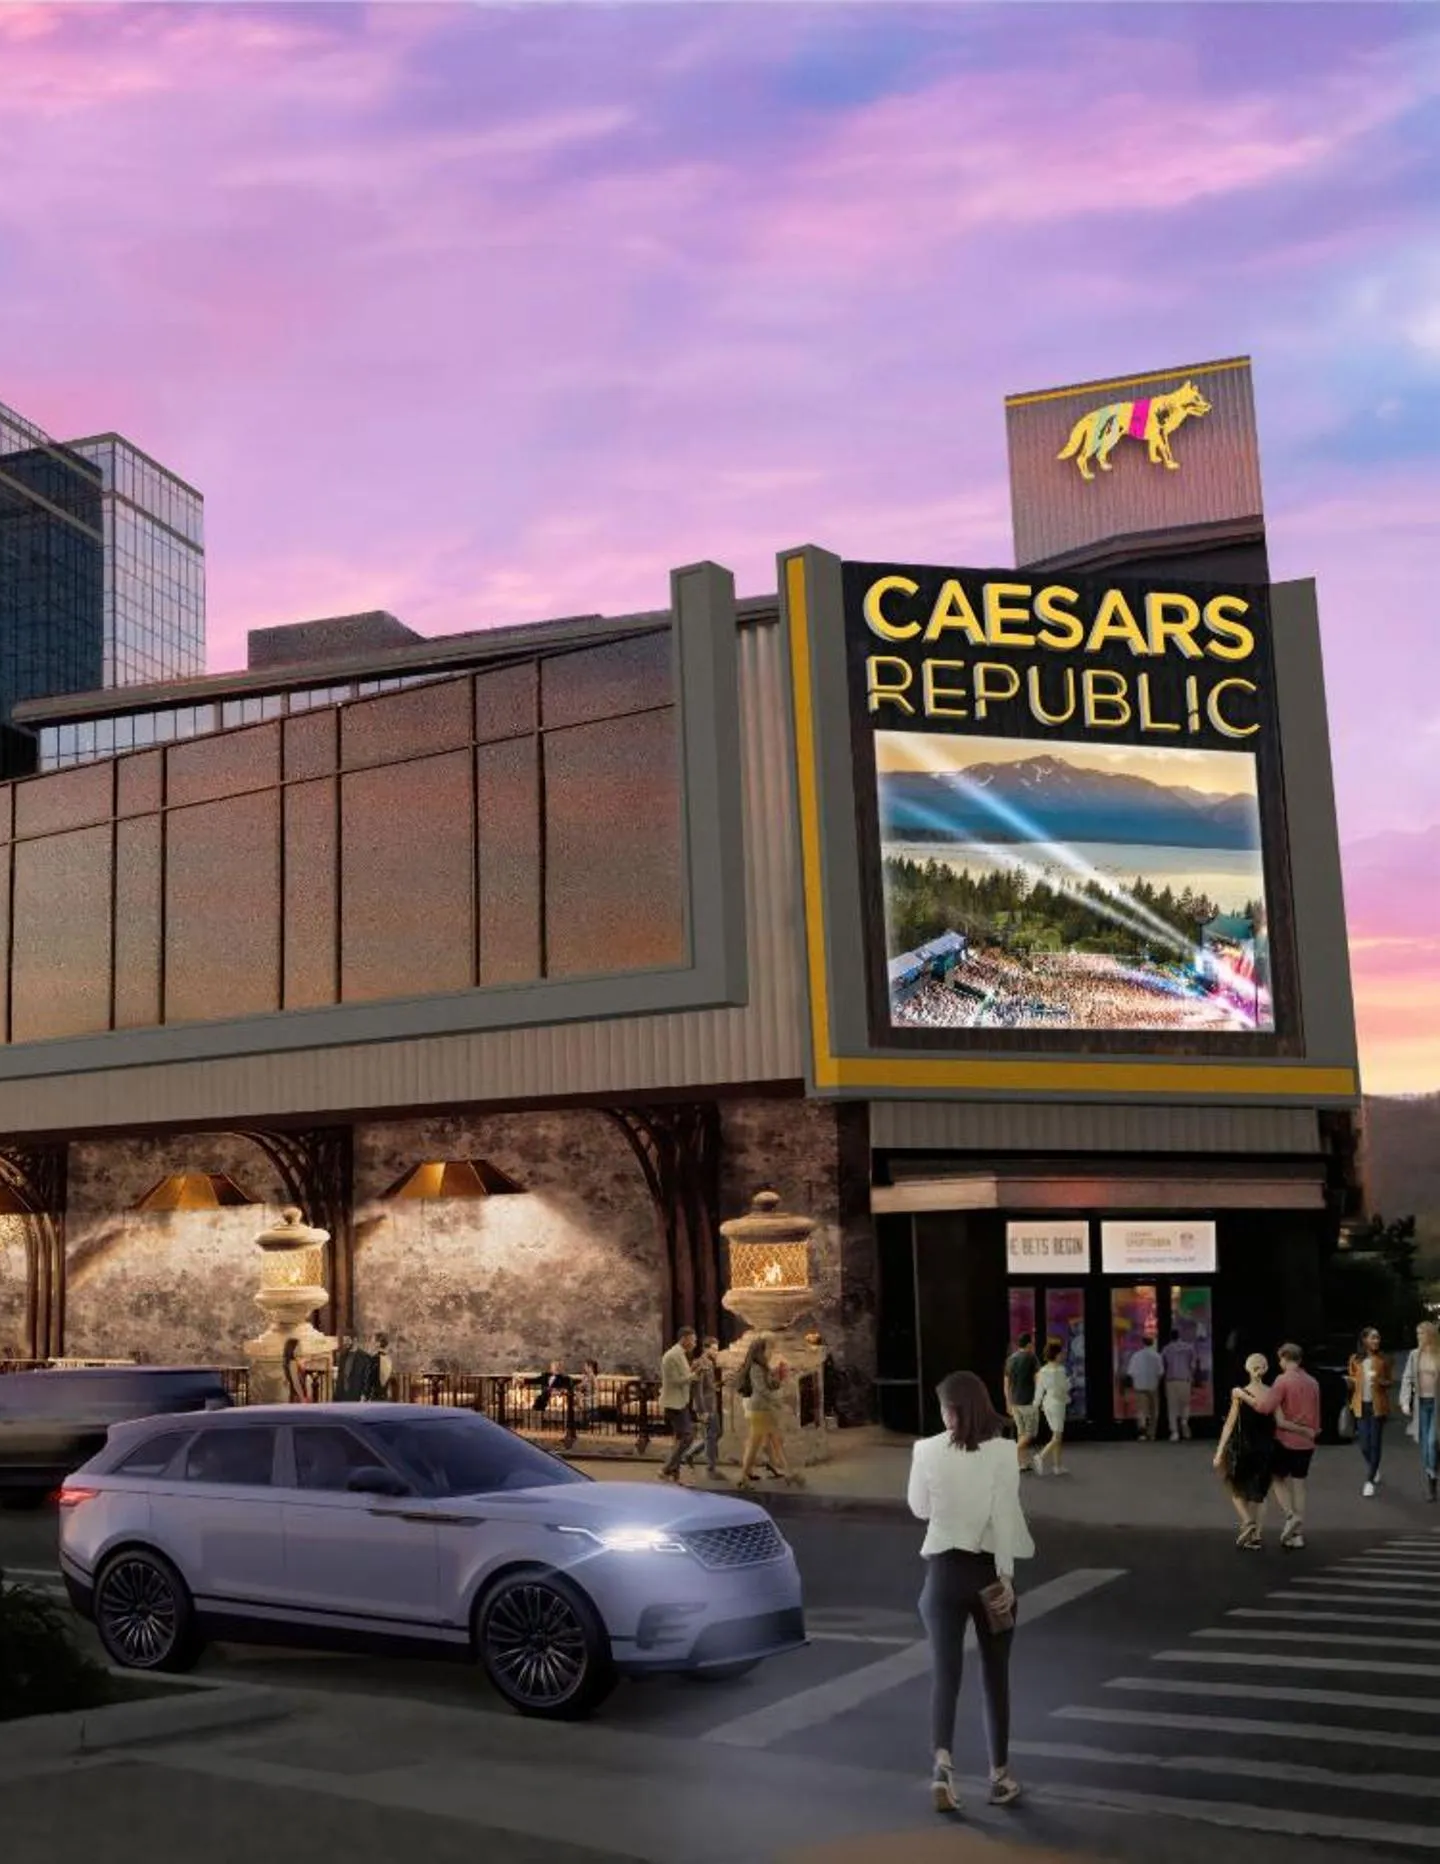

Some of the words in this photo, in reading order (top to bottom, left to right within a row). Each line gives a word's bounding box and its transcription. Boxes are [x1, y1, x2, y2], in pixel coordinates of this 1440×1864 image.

[863, 575, 1255, 661] CAESARS
[866, 655, 1261, 738] REPUBLIC
[1022, 1238, 1049, 1255] BETS
